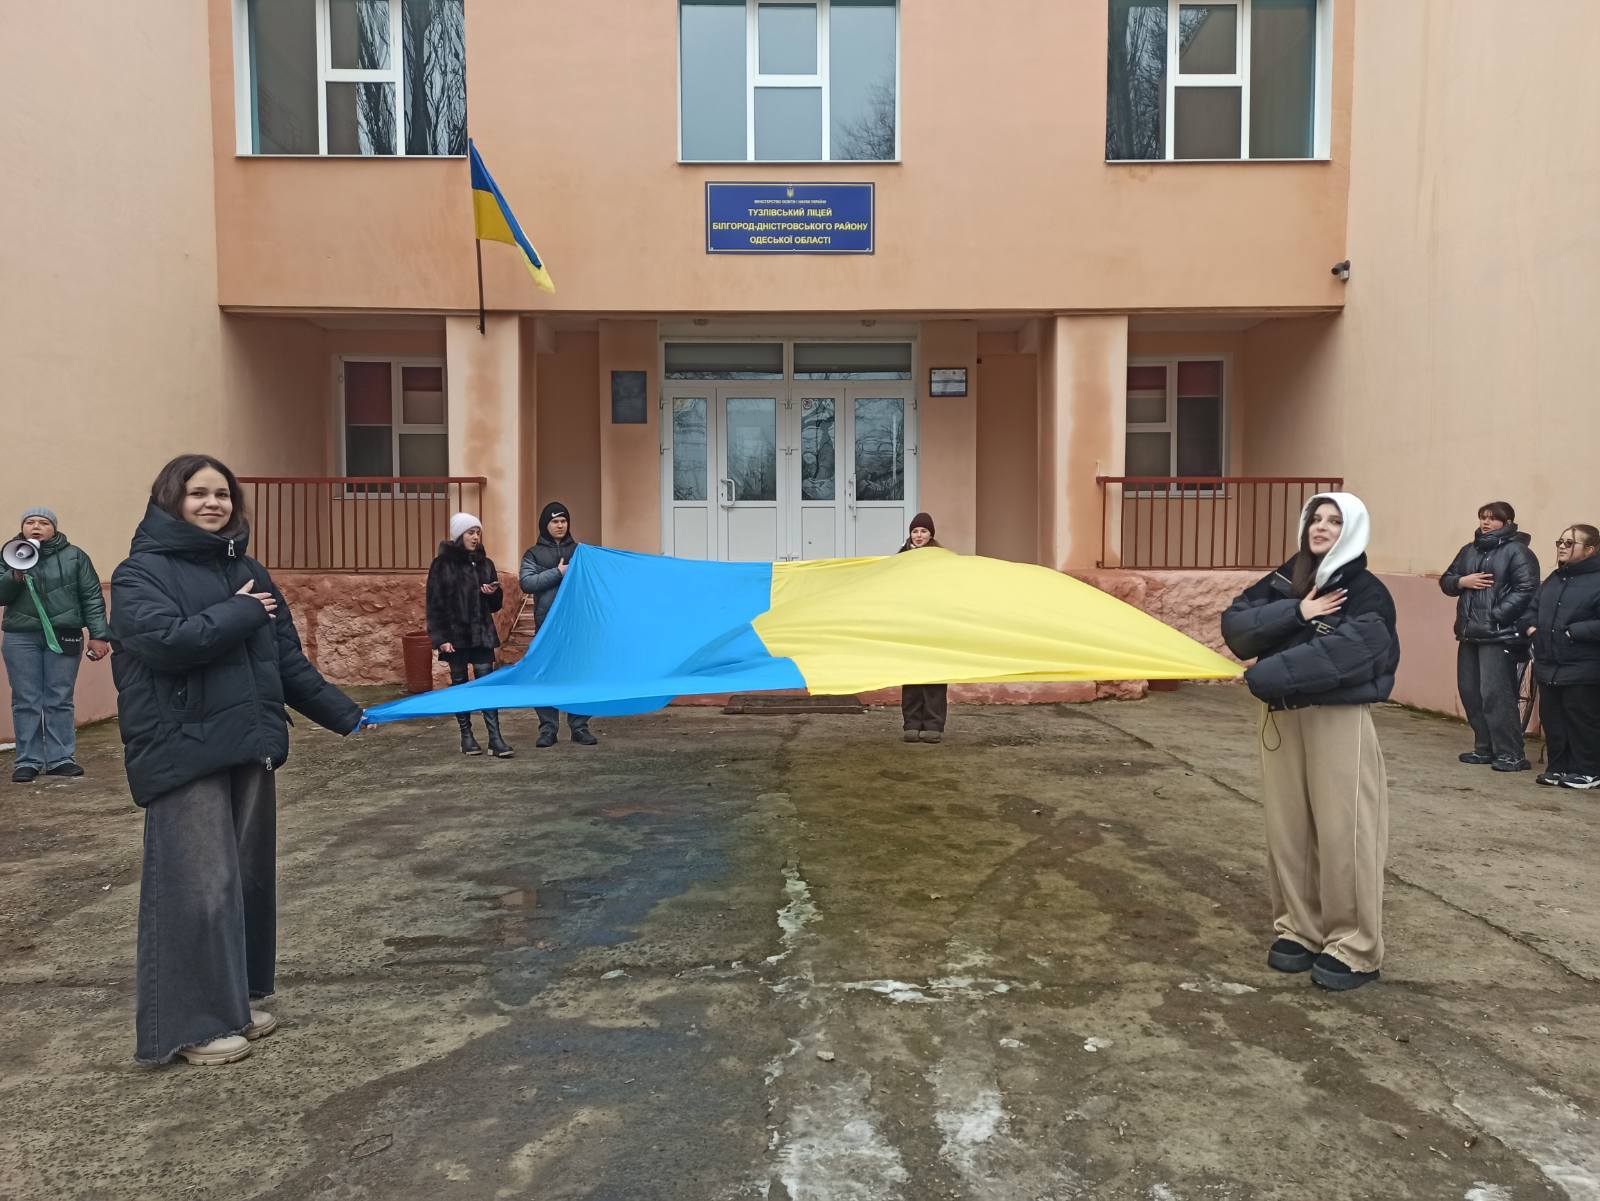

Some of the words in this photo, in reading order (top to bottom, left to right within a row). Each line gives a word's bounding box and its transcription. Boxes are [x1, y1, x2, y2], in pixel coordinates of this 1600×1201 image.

[748, 208, 804, 217] ТУЗЛІВСЬКИЙ
[807, 208, 832, 218] ЛІЦЕЙ
[712, 222, 832, 231] БІЛГОРОД-ДНІСТРОВСЬКОГО
[834, 221, 868, 231] РАЙОНУ
[749, 235, 793, 245] ОДЕСЬКОЇ
[794, 236, 831, 244] ОБЛАСТІ
